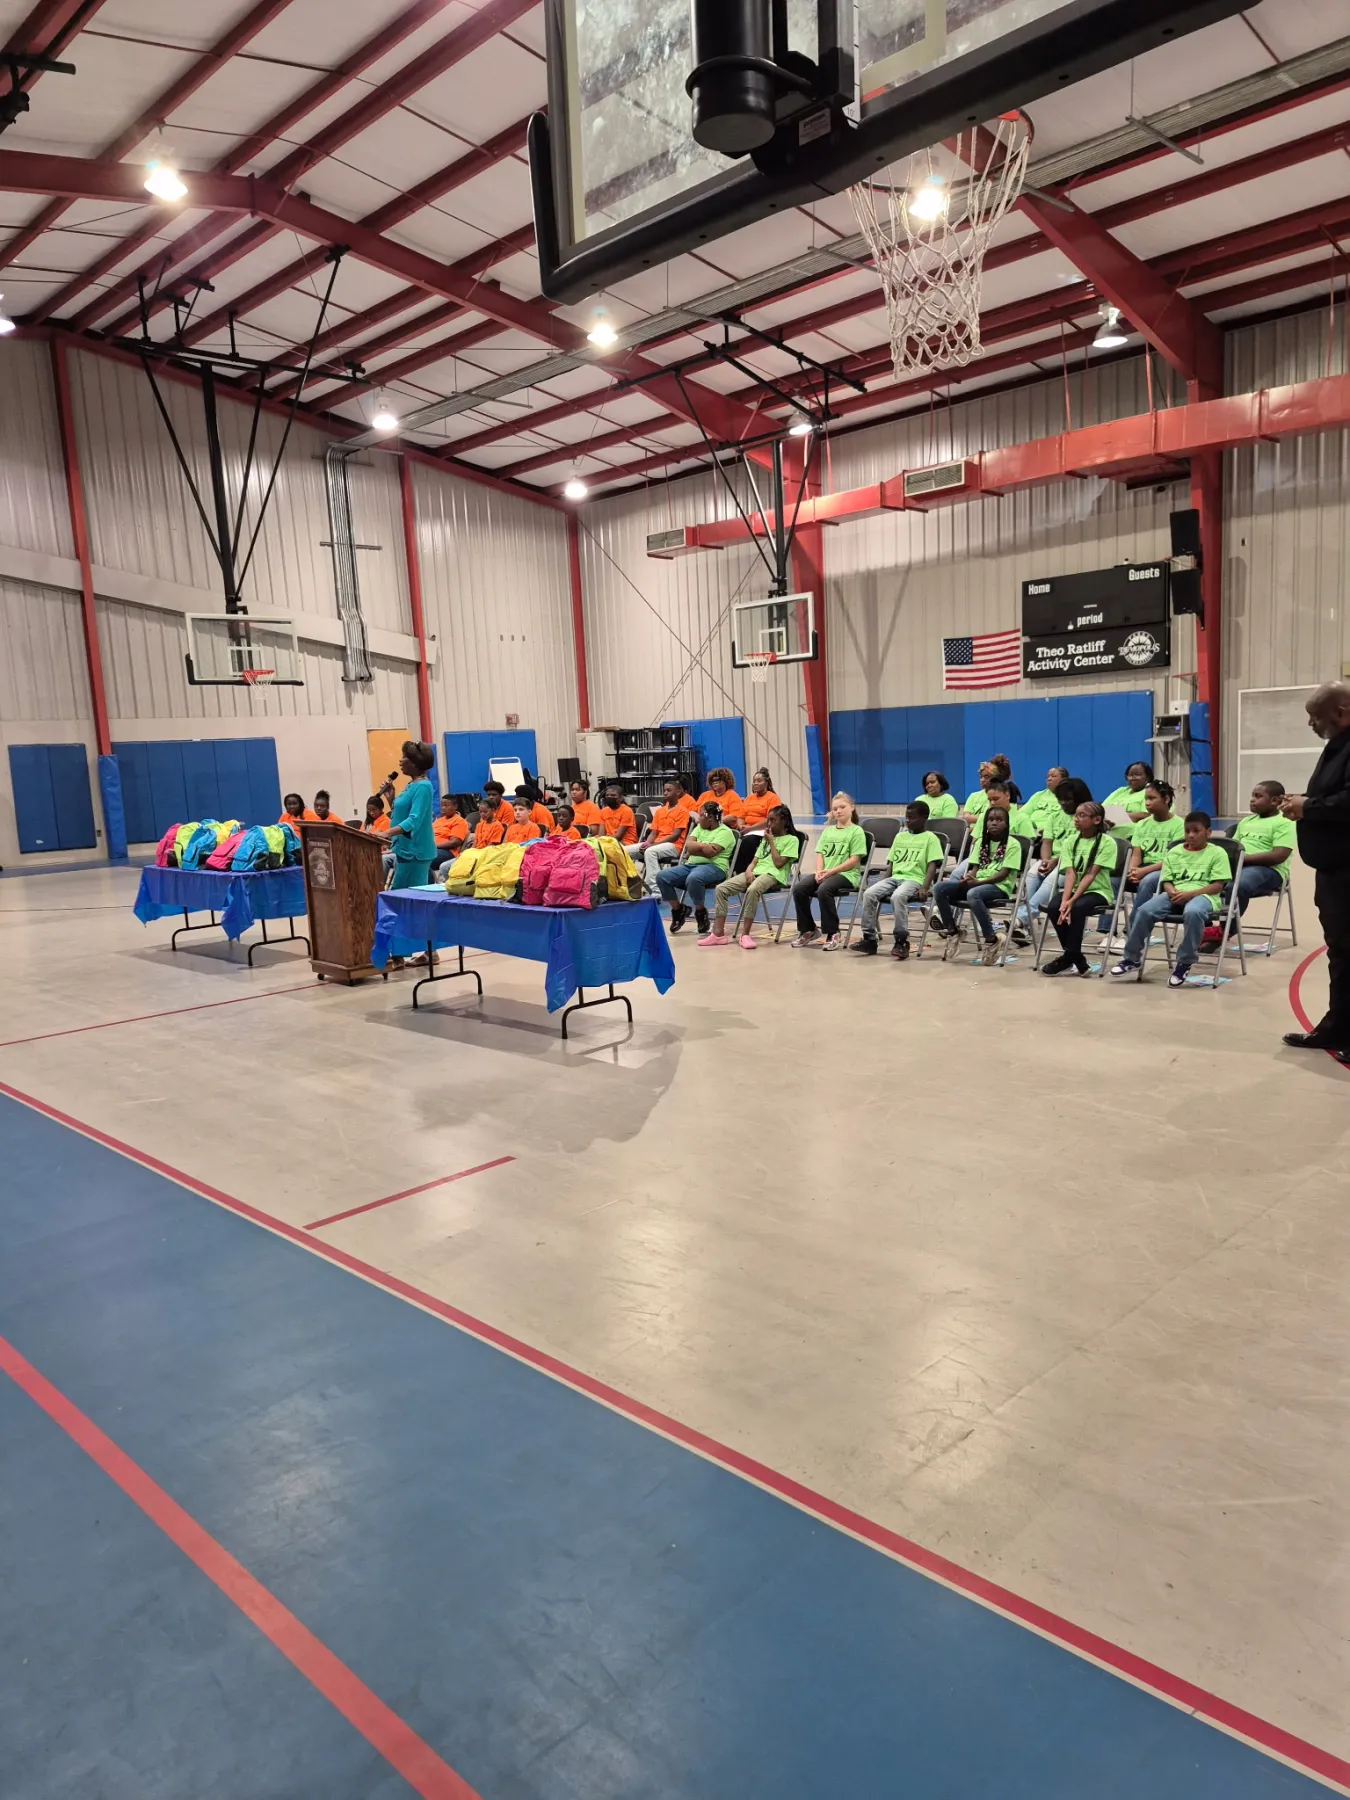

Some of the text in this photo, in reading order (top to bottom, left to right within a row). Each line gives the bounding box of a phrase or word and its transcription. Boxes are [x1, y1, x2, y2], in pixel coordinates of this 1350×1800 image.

[1129, 568, 1160, 581] Guests
[1028, 584, 1050, 595] Home
[1077, 612, 1103, 628] period
[1036, 640, 1106, 658] Theo Ratliff
[1027, 658, 1071, 671] Activity
[1074, 655, 1115, 667] Center
